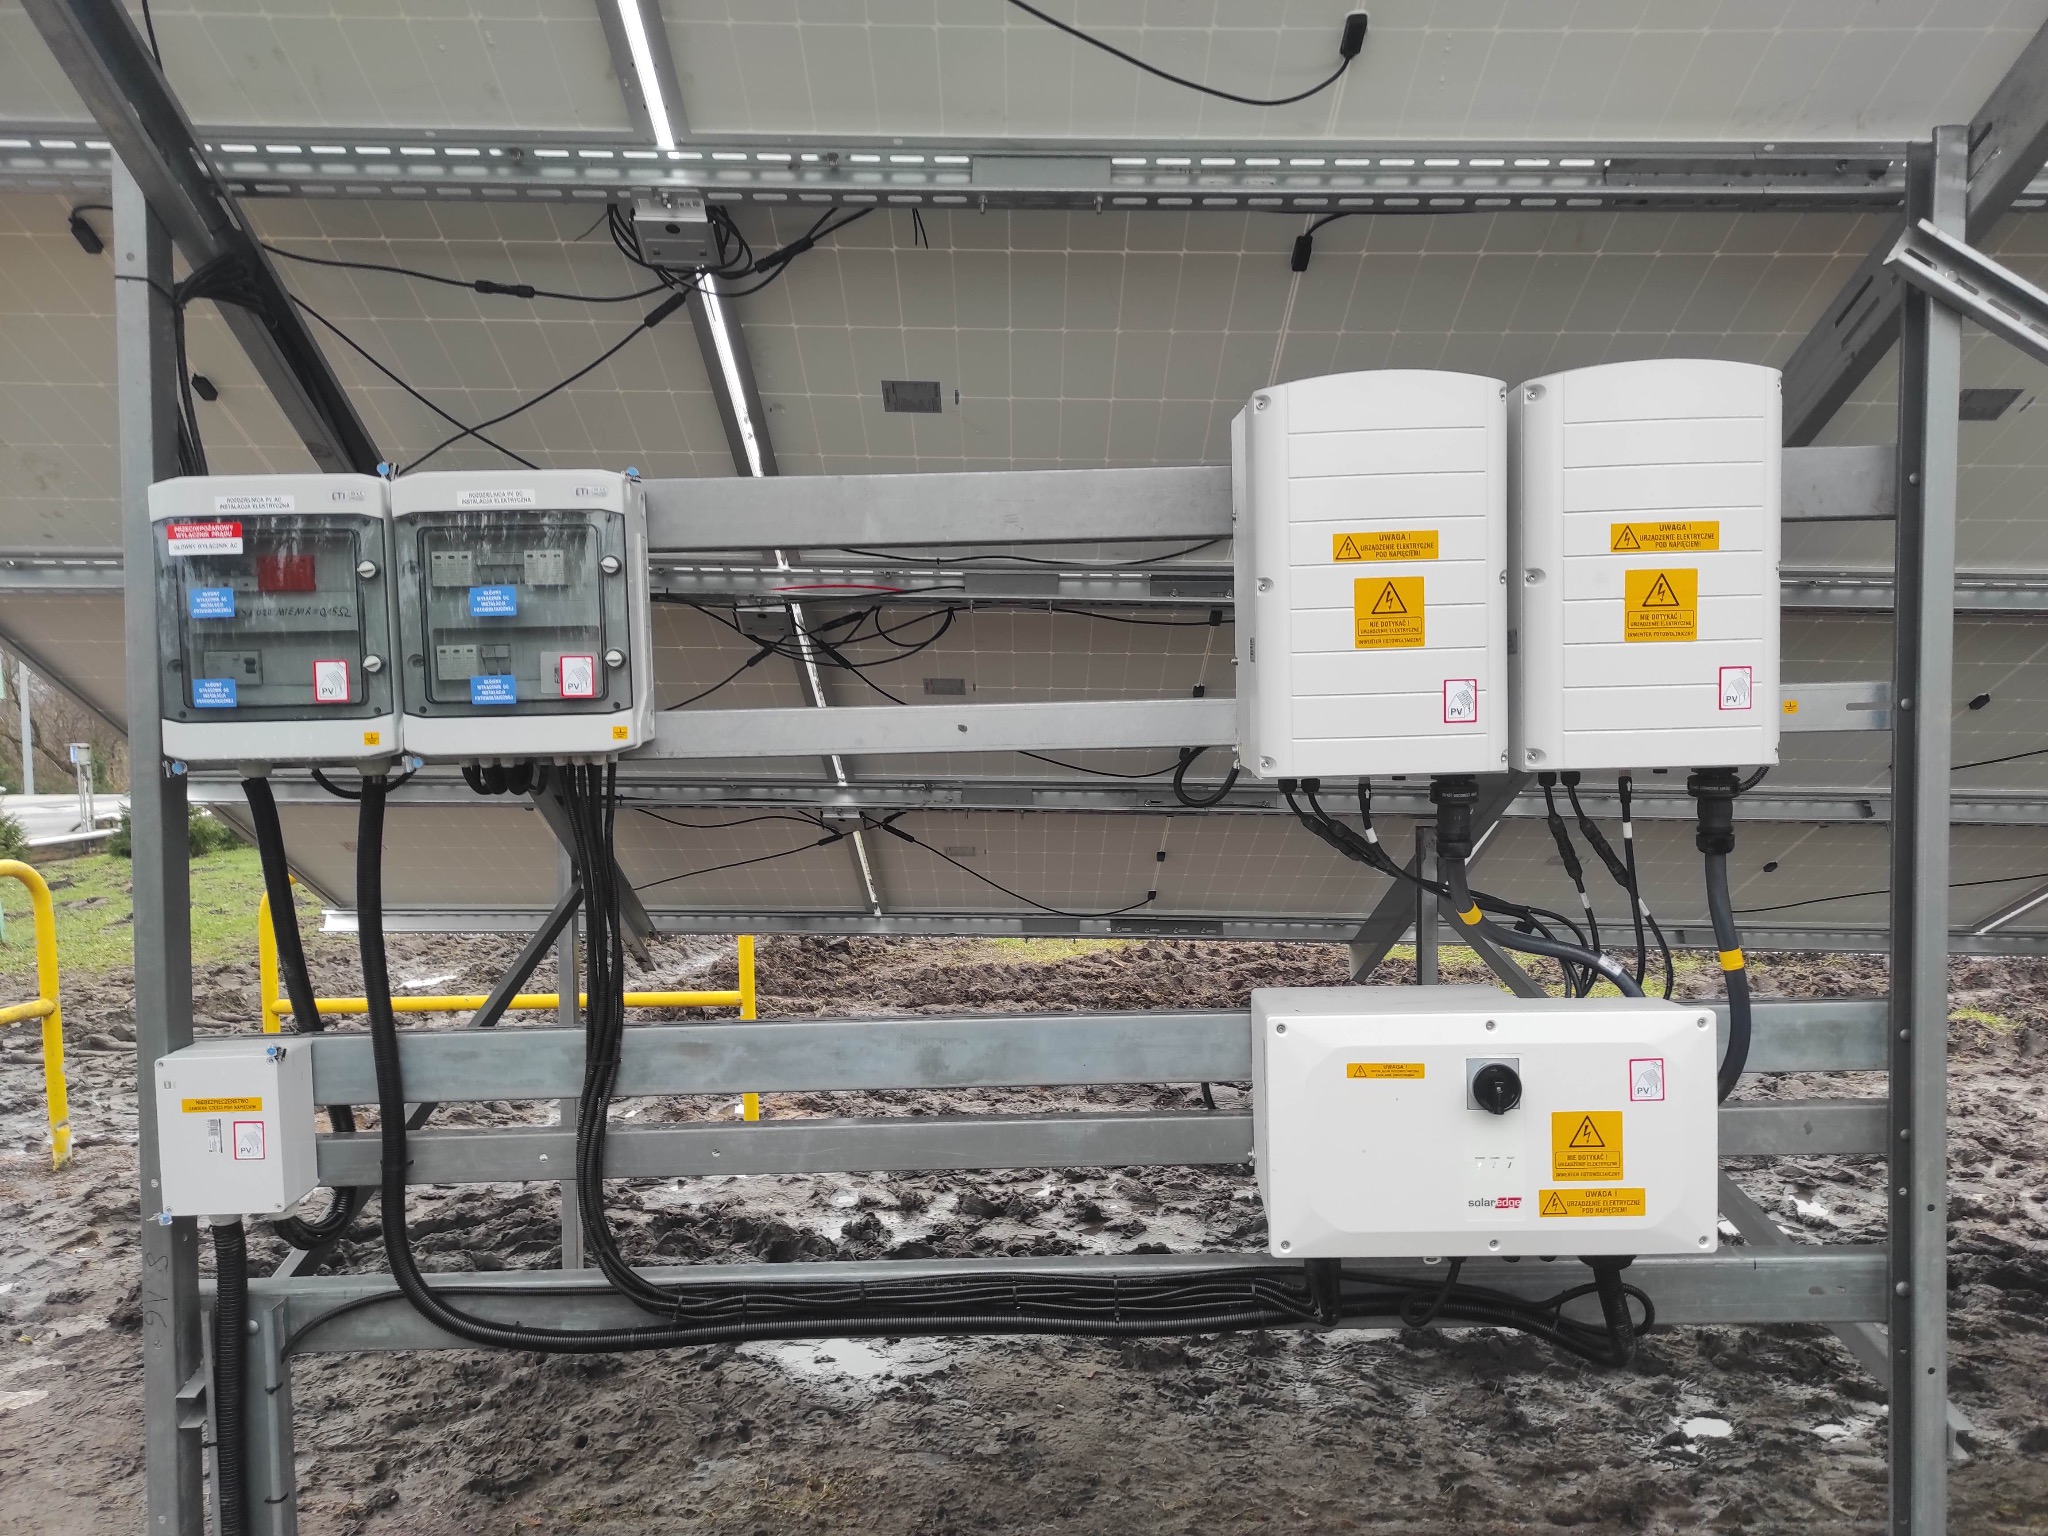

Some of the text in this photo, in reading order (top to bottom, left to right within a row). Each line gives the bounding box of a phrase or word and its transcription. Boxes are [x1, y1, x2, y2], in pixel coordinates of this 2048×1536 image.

[1640, 534, 1674, 542] URZĄDZENIE
[1360, 544, 1394, 552] URZĄDZENIE
[322, 687, 334, 695] PV
[567, 683, 580, 691] PV
[1468, 1198, 1522, 1208] solaredge
